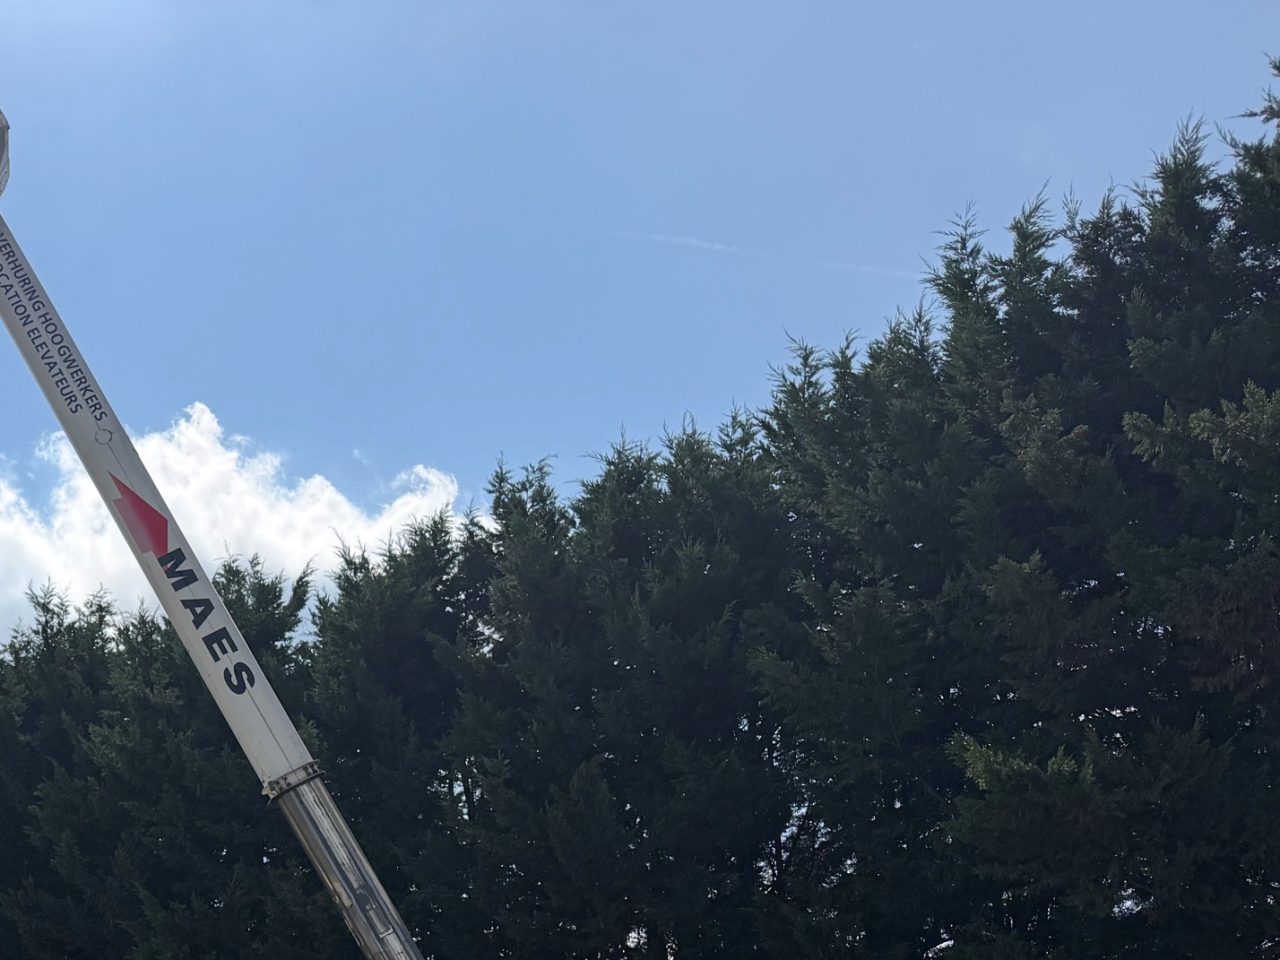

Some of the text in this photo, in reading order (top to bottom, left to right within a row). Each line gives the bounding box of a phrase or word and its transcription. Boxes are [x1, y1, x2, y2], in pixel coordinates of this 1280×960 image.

[26, 326, 84, 414] ELEVATEURS
[38, 312, 109, 422] HOOGWERKERS
[157, 547, 256, 695] MAES
